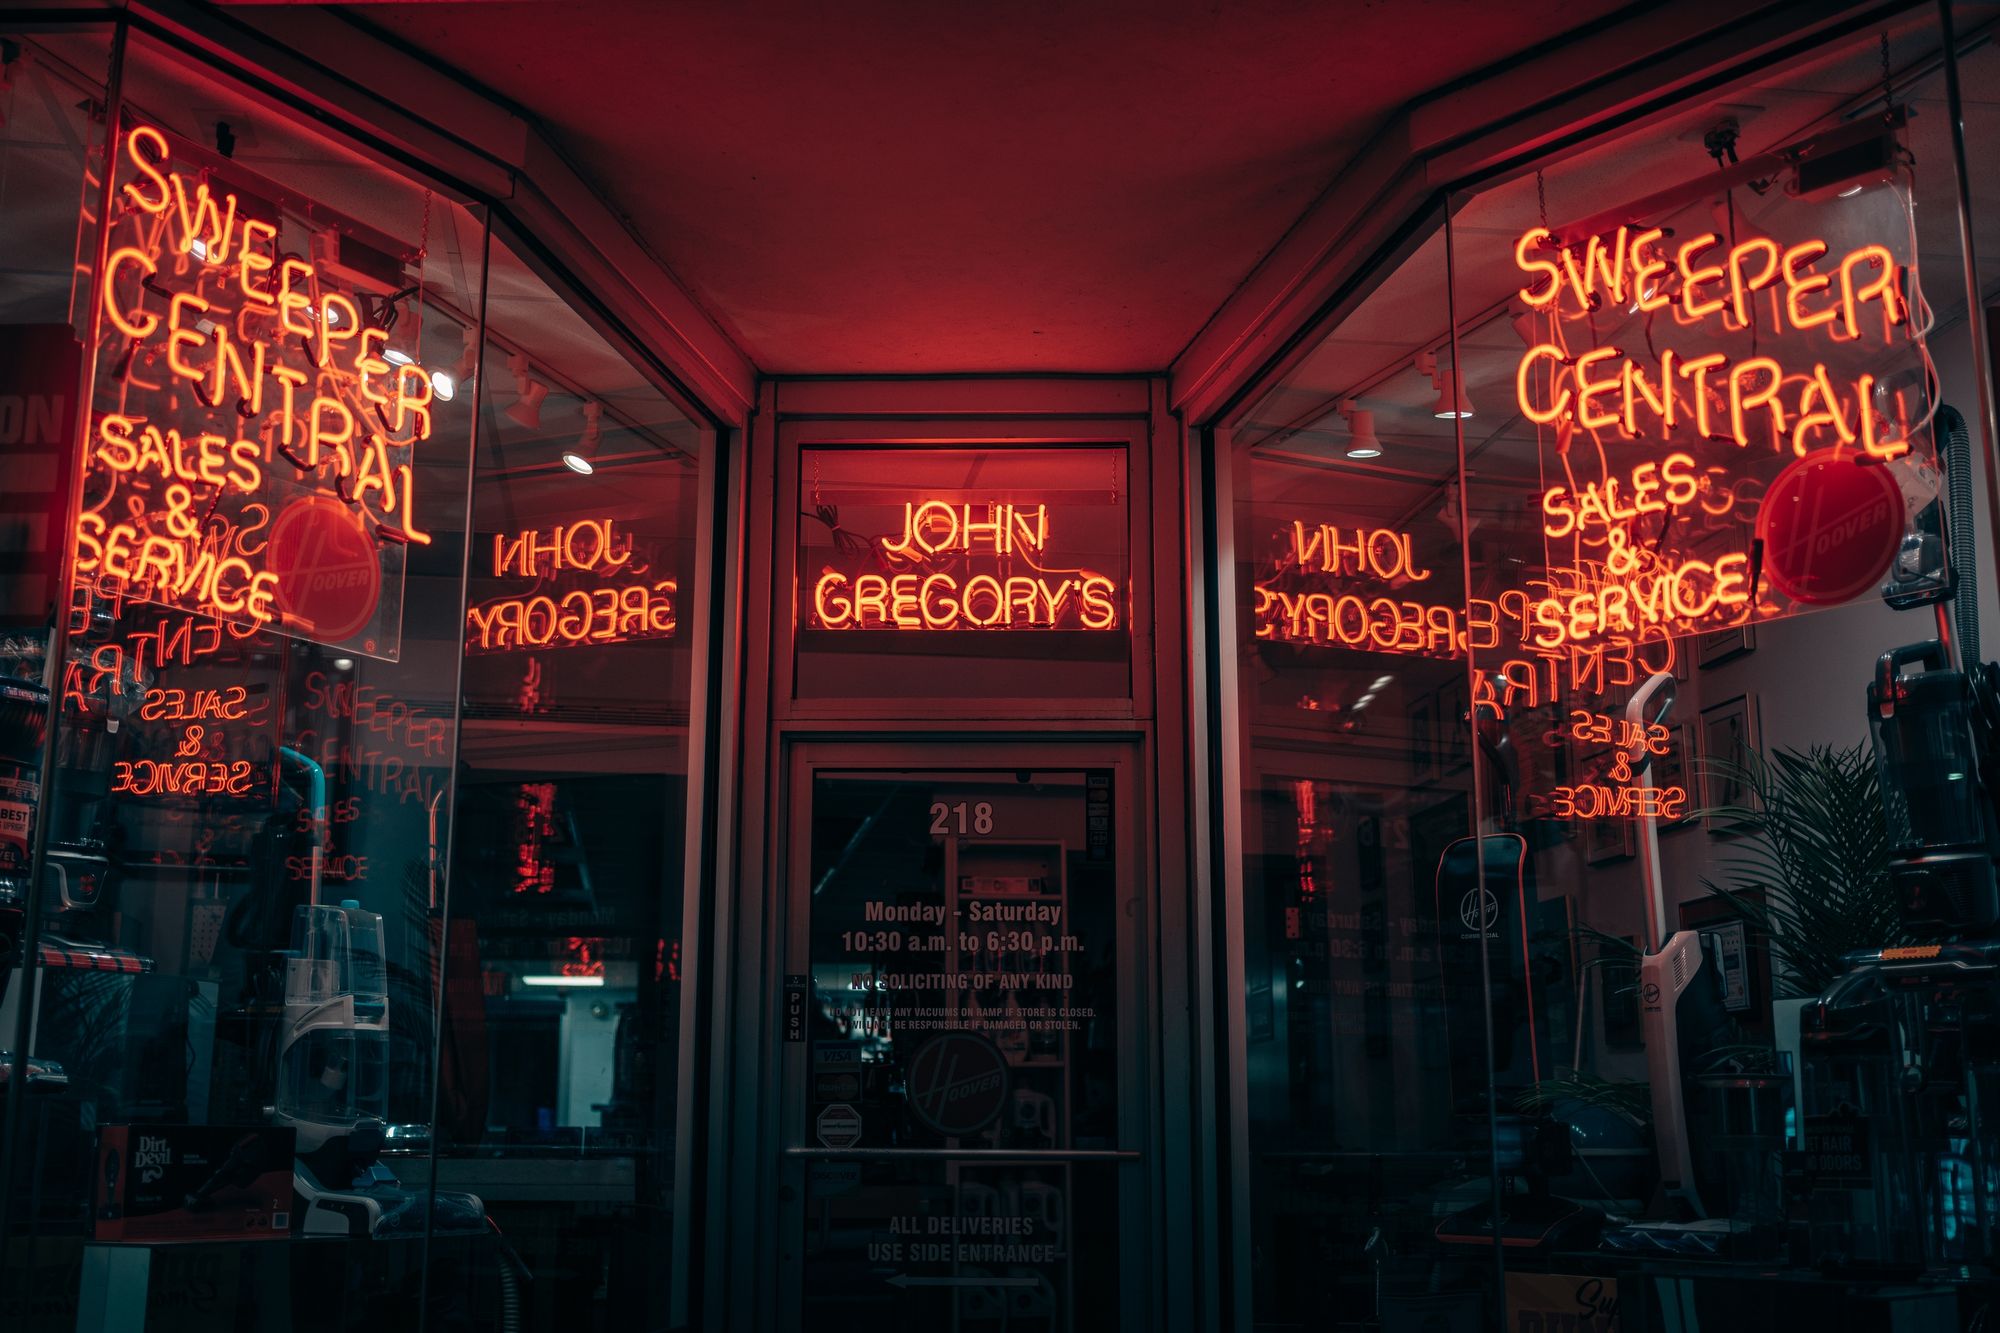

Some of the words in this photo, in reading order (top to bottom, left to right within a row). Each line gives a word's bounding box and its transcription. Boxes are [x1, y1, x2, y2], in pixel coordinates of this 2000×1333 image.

[122, 126, 432, 440] SWEEPER
[1515, 225, 1901, 340] SWEEPER
[104, 247, 431, 545] CENTRAL
[1517, 344, 1910, 460] CENTRAL
[96, 414, 261, 491] SALES
[164, 484, 199, 538] &
[1543, 452, 1699, 538] SALES
[882, 501, 1046, 554] JOHN
[75, 512, 280, 622] SERVICE
[1607, 528, 1641, 576] &
[814, 573, 1115, 628] GREGORY'S
[1535, 553, 1750, 649] SERVICE
[929, 802, 993, 835] 218
[865, 901, 946, 926] Monday
[969, 901, 1062, 926] Saturday
[842, 931, 902, 952] 10:30
[908, 935, 952, 952] a.m.
[959, 931, 980, 952] to
[986, 931, 1034, 952] 6:30
[1041, 935, 1085, 957] p.m.
[852, 974, 874, 990] NO
[879, 974, 968, 990] SOLICITING
[973, 974, 994, 990] OF
[1000, 974, 1030, 990] ANY
[1036, 974, 1073, 990] KIND
[789, 992, 801, 1040] PUSH
[865, 1007, 891, 1018] LEAVE
[894, 1007, 913, 1018] ANY
[914, 1007, 958, 1018] VACUUMS
[961, 1007, 973, 1018] ON
[976, 1007, 1002, 1018] RAMP
[1005, 1007, 1014, 1018] IF
[1016, 1007, 1045, 1018] STORE
[1048, 1007, 1057, 1018] IS
[1059, 1007, 1097, 1018] CLOSED.
[894, 1020, 907, 1031] BE
[908, 1020, 969, 1031] RESPONSIBLE
[972, 1020, 981, 1031] IF
[983, 1020, 1027, 1031] DAMAGED
[1029, 1020, 1042, 1031] OR
[1045, 1020, 1082, 1031] STOLEN.
[822, 1049, 853, 1062] VISA
[134, 1147, 174, 1169] Devil
[139, 1135, 168, 1152] Dirt
[889, 1216, 921, 1235] ALL
[927, 1216, 1034, 1236] DELIVERIES
[867, 1242, 902, 1263] USE
[909, 1242, 951, 1263] SIDE
[958, 1243, 1055, 1263] ENTRANCE
